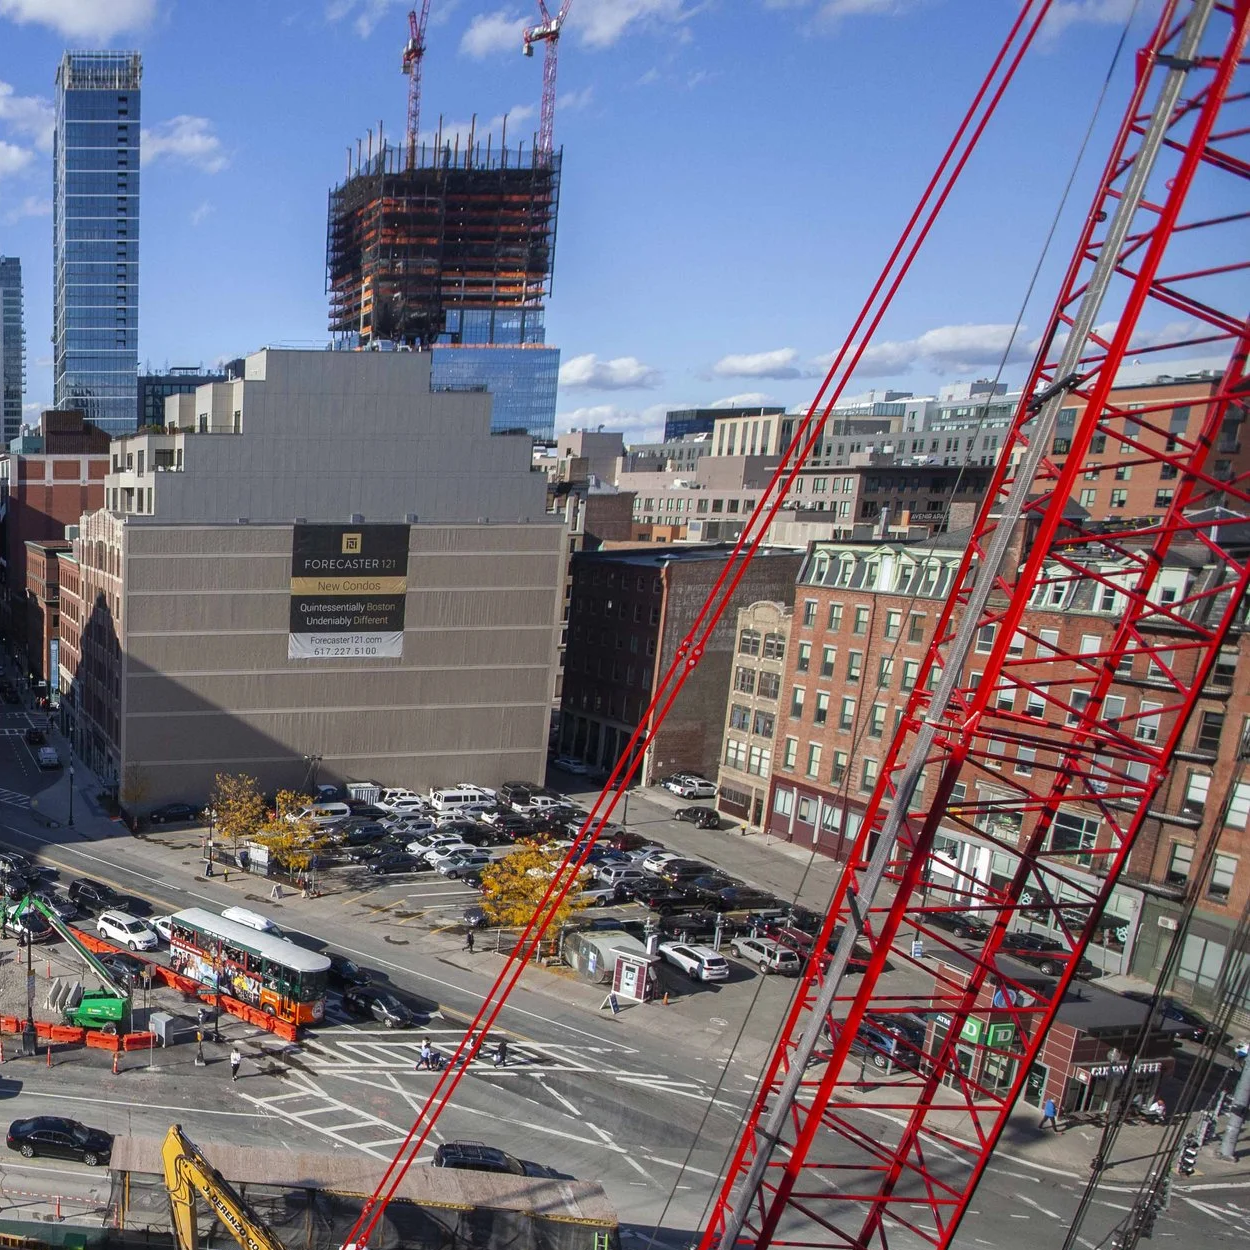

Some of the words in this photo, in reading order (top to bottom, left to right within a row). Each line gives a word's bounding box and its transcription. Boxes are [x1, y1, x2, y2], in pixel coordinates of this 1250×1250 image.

[305, 559, 379, 569] FORECASTER
[381, 559, 396, 569] 121
[317, 581, 340, 591] New
[342, 580, 381, 591] Condos
[300, 602, 365, 614] Quintessentially
[367, 602, 396, 611] Boston
[306, 616, 352, 627] Undeniably
[353, 616, 388, 625] Different
[310, 636, 382, 645] Forecaster121.com
[314, 647, 377, 656] 617.227.5100
[936, 1014, 951, 1026] ATM
[995, 1029, 1012, 1042] TD
[202, 1185, 211, 1197] J.
[211, 1195, 247, 1238] DERENZO
